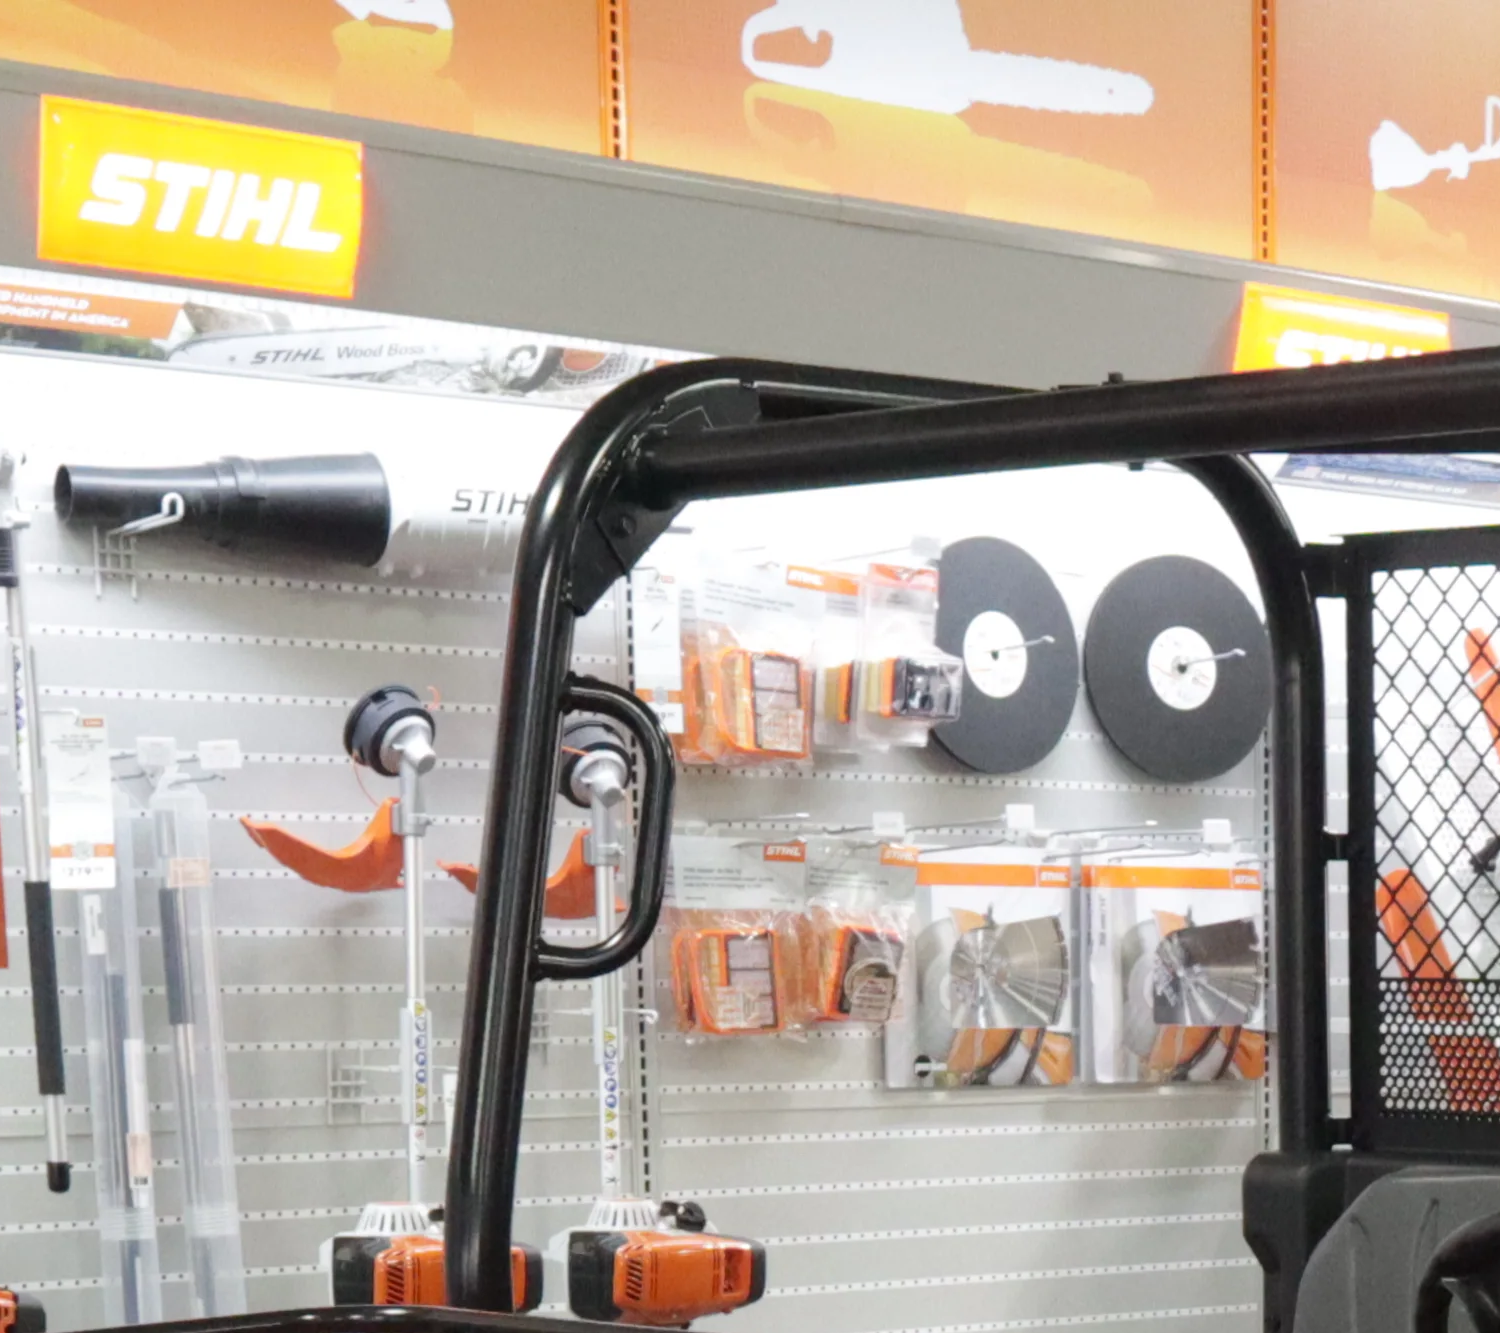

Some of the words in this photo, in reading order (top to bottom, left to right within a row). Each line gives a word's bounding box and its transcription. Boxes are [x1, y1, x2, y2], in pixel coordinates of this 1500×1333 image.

[79, 152, 342, 252] STIHL
[69, 311, 129, 328] AMERICA
[249, 346, 325, 366] STIHL
[336, 343, 384, 361] Wood
[451, 488, 533, 516] STIH
[765, 844, 802, 858] STIHL
